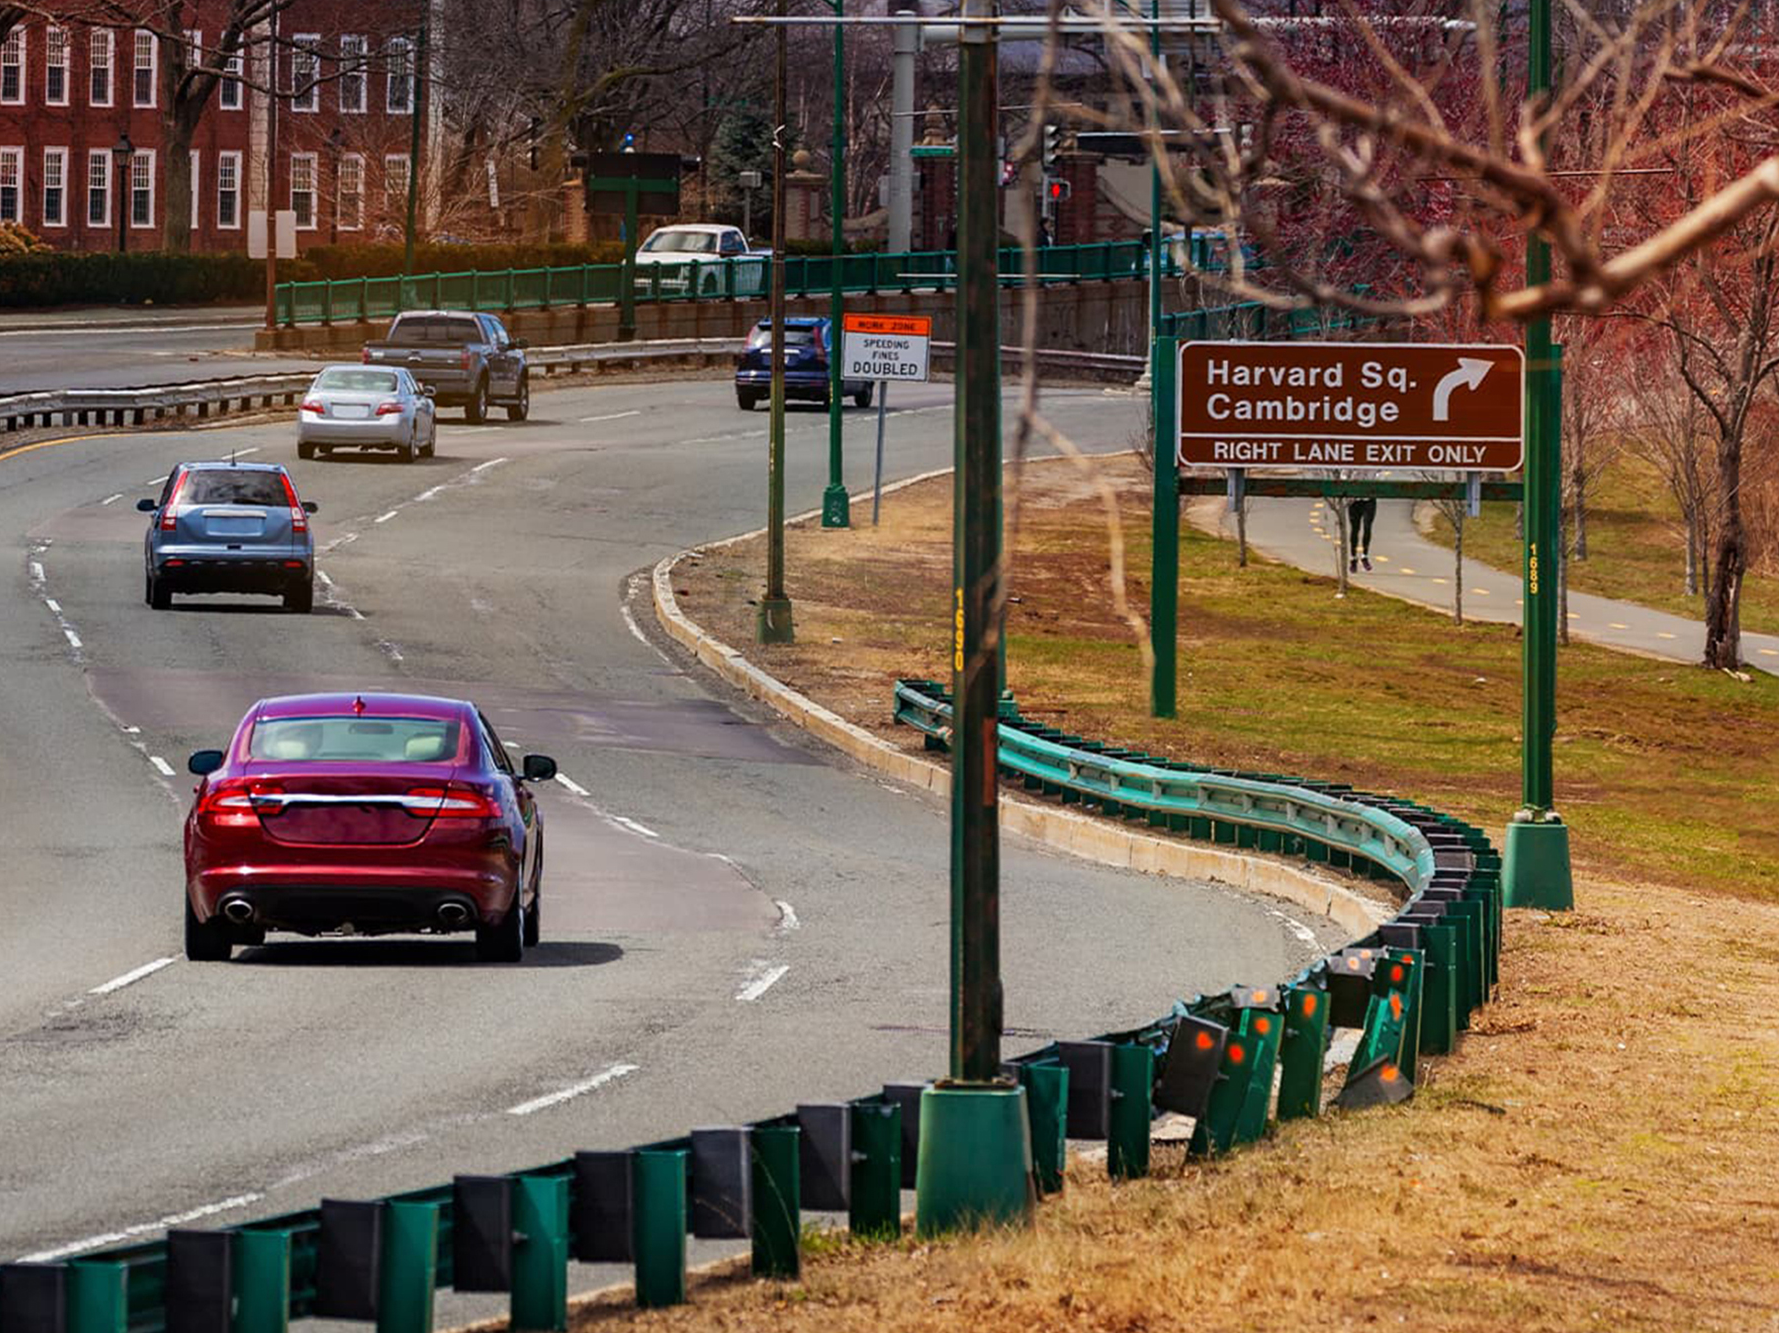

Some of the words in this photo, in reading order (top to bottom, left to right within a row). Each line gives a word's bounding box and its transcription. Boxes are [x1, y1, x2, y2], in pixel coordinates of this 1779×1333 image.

[863, 338, 910, 350] SPEEDING
[872, 350, 899, 361] FINES
[853, 361, 918, 376] DOUBLED
[1207, 359, 1343, 387] Harvard
[1362, 361, 1417, 393] Sq.
[1207, 393, 1400, 428] Cambridge
[1214, 441, 1282, 461] RIGHT
[1294, 443, 1354, 462] LANE
[1366, 444, 1416, 463] EXIT
[1428, 445, 1487, 464] ONLY
[1530, 543, 1538, 594] 1689
[955, 587, 964, 672] 1690
